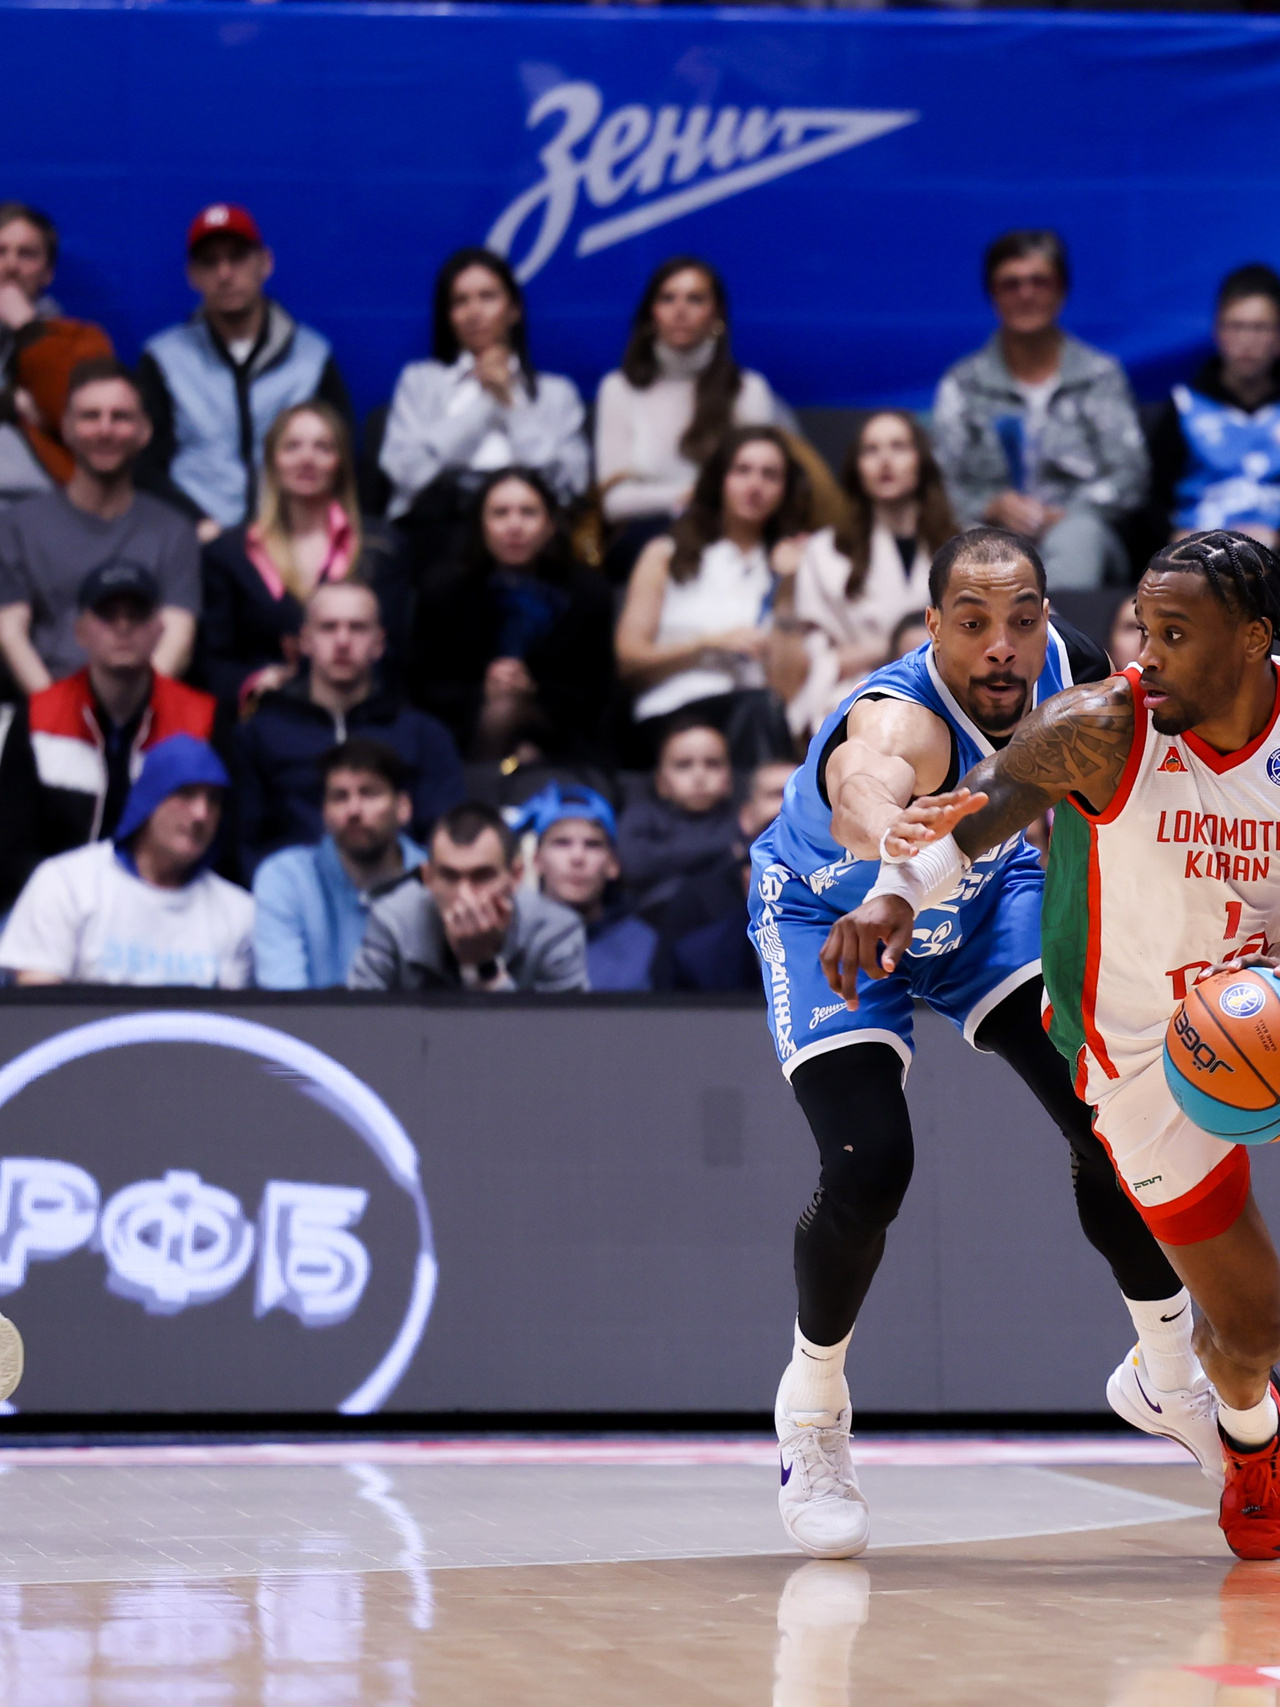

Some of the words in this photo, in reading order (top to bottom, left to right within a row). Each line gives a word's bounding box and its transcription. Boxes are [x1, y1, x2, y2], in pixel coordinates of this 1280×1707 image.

[485, 81, 920, 285] Зенит
[1223, 901, 1243, 940] 1
[0, 1156, 371, 1328] РФБ
